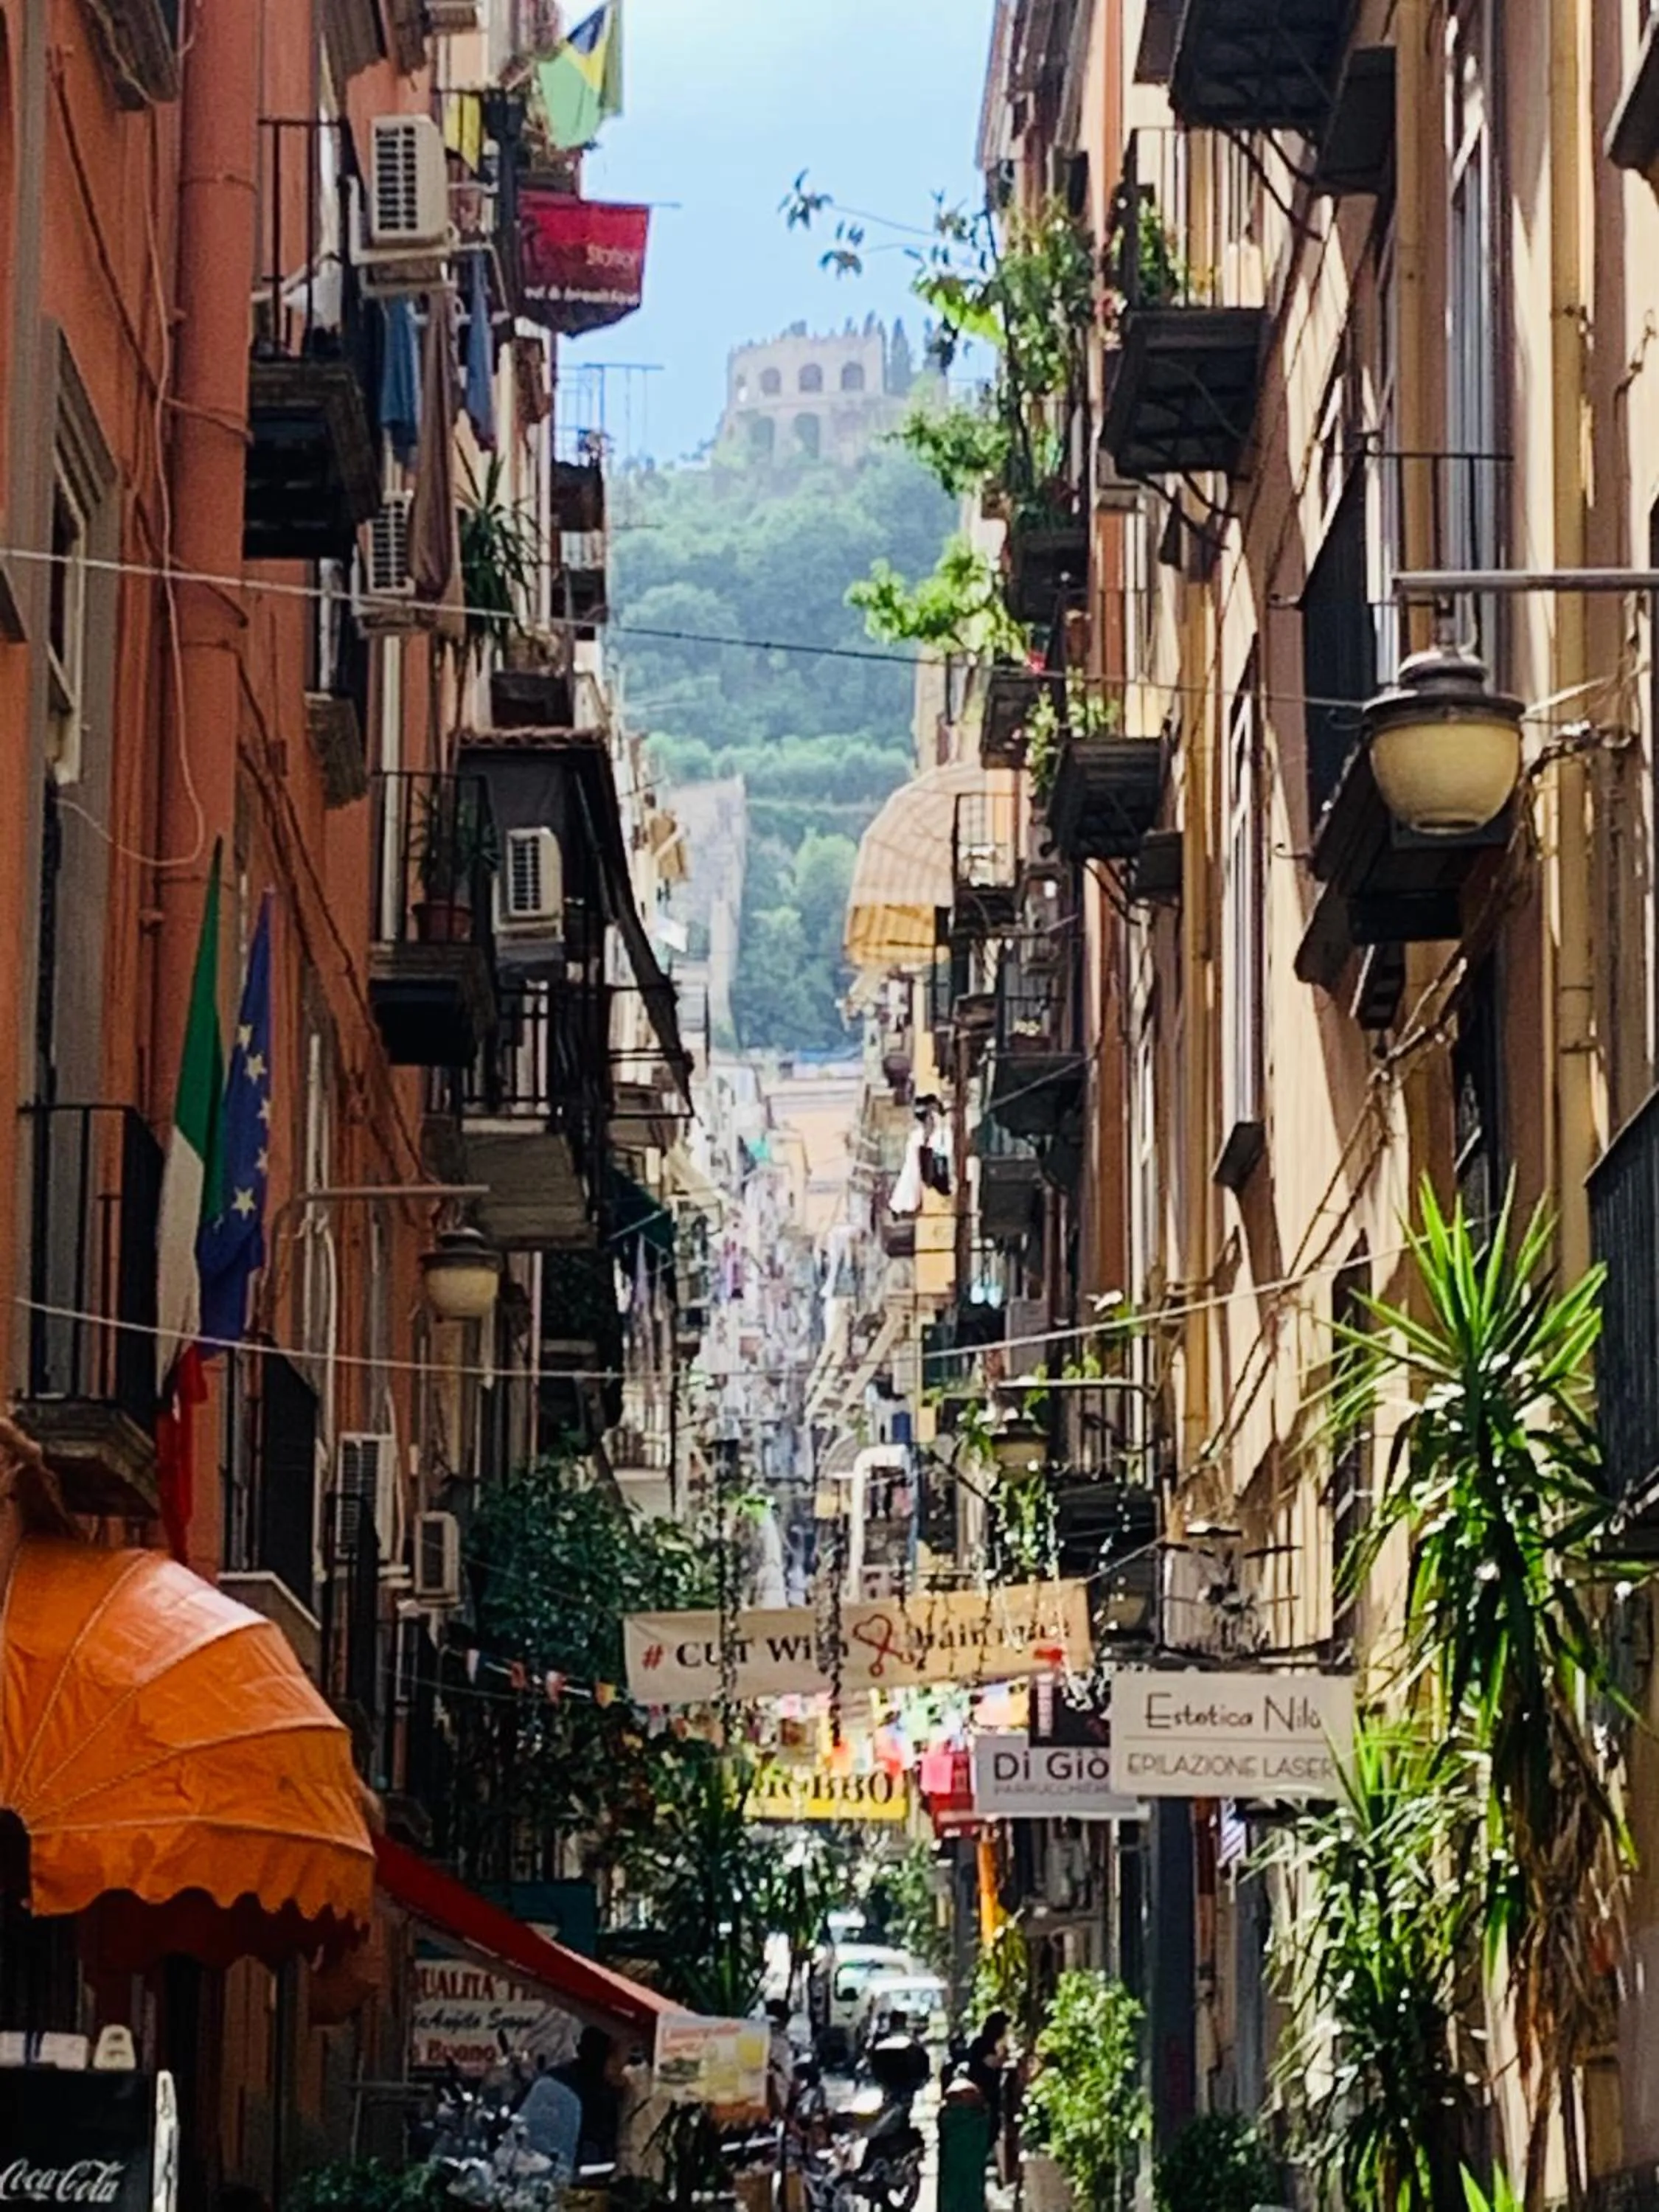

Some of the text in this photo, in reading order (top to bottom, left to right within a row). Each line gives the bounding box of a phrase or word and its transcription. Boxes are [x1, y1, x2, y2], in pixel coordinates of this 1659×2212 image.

[993, 1750, 1030, 1781] Di
[1127, 1753, 1335, 1780] EPILAZIONE LASER
